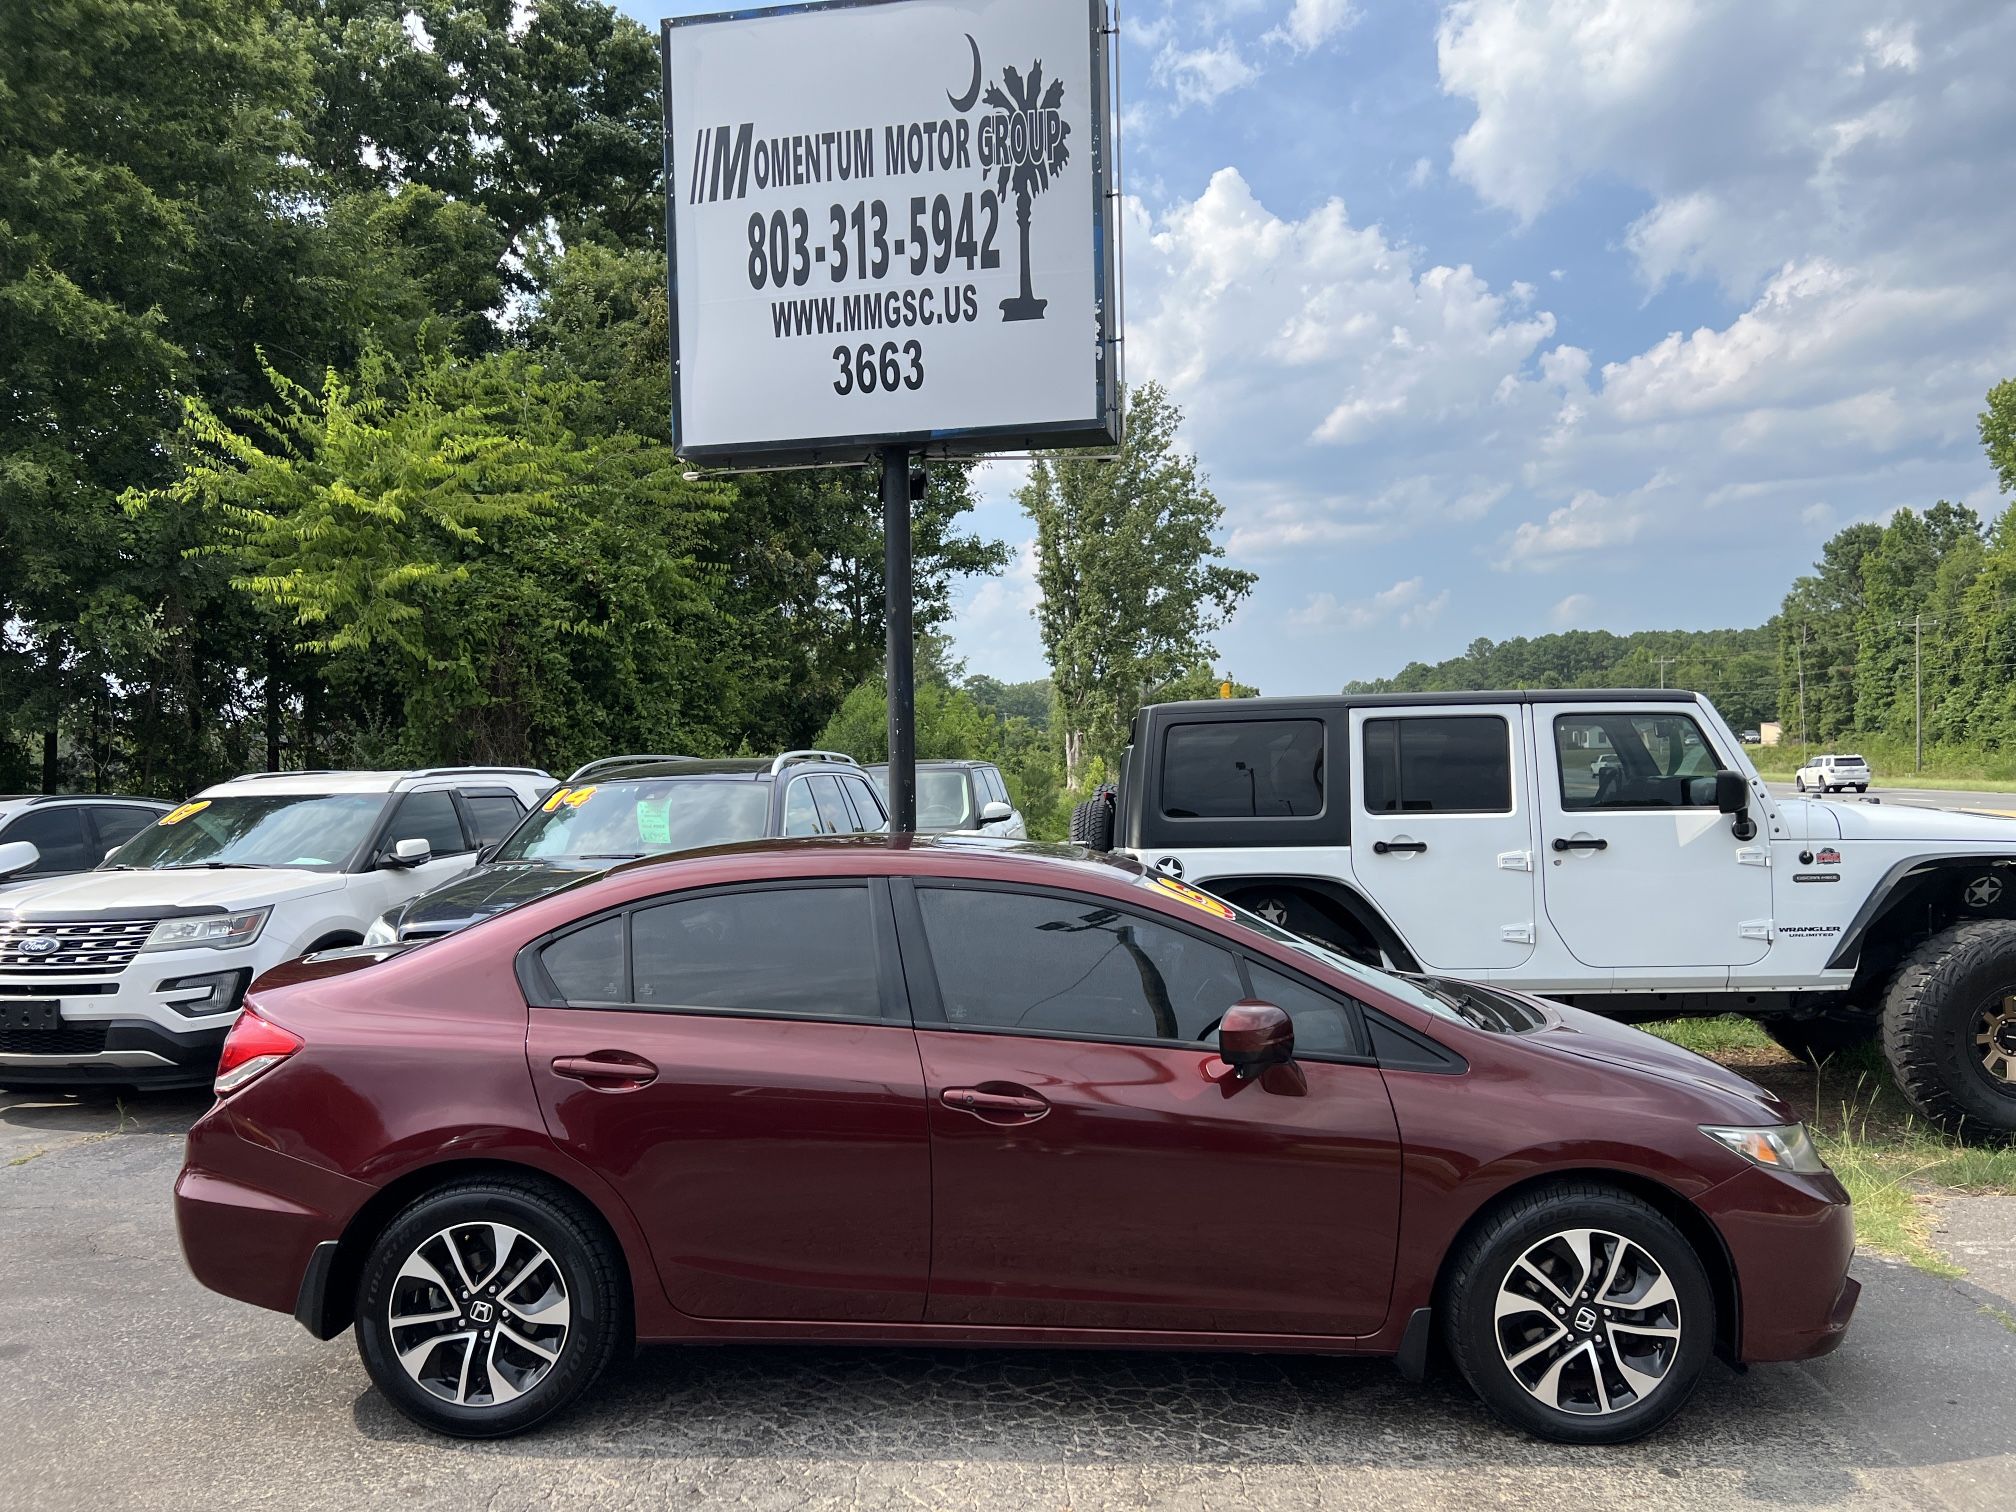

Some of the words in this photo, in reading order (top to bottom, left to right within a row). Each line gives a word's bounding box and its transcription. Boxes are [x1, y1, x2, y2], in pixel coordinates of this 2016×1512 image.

[885, 118, 971, 176] MOTOR
[977, 107, 1063, 170] GROUP
[747, 189, 1001, 291] 803-313-5942
[771, 284, 978, 339] WWW.MMGSC.US
[832, 339, 925, 396] 3663
[542, 786, 597, 812] 14
